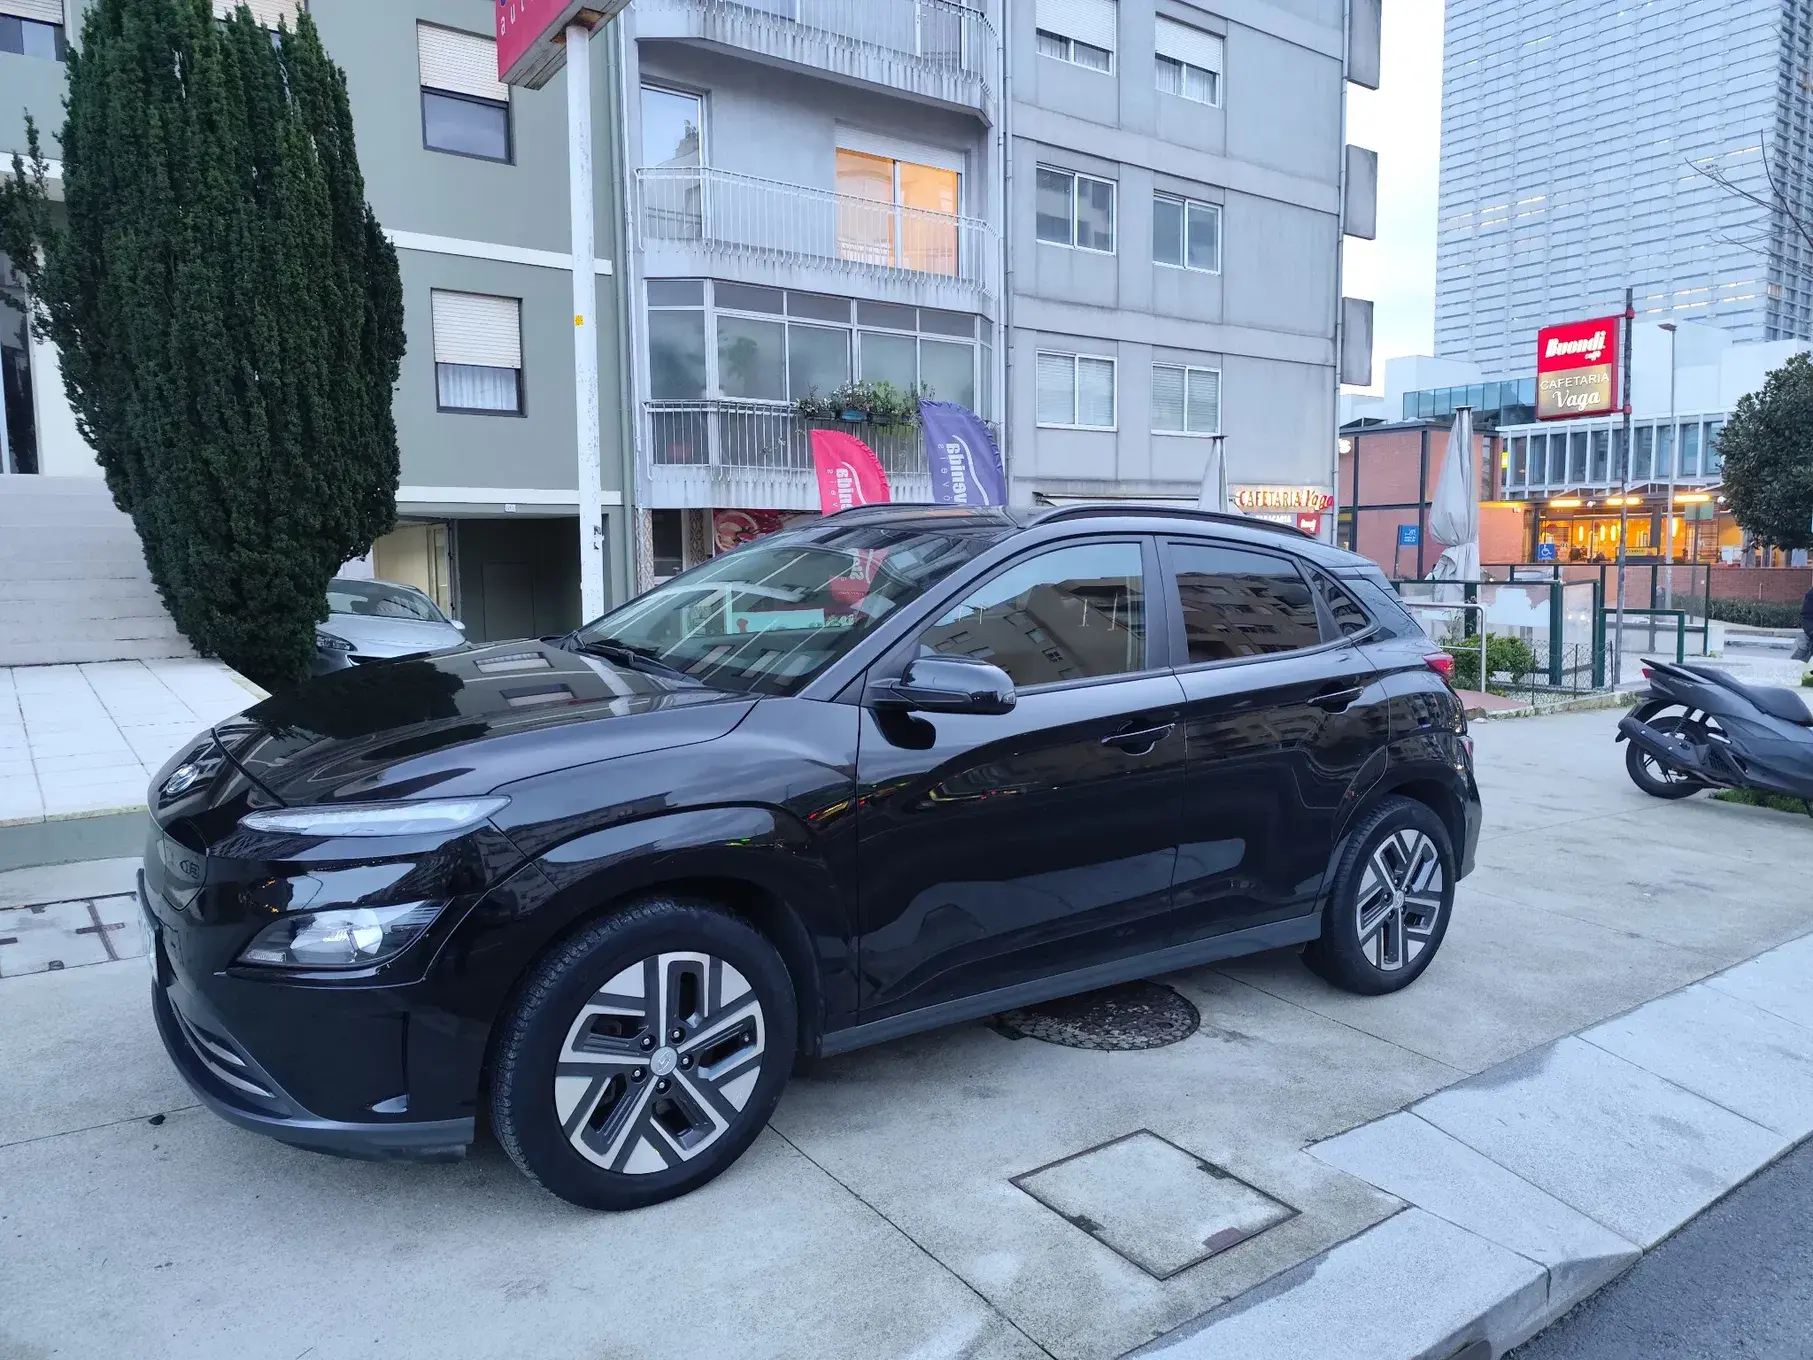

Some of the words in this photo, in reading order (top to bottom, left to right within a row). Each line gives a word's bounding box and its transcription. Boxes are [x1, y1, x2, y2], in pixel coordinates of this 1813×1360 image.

[1540, 373, 1609, 390] CAFETARIA
[1552, 390, 1601, 411] Vaga
[1239, 490, 1302, 507] CAFETARIA
